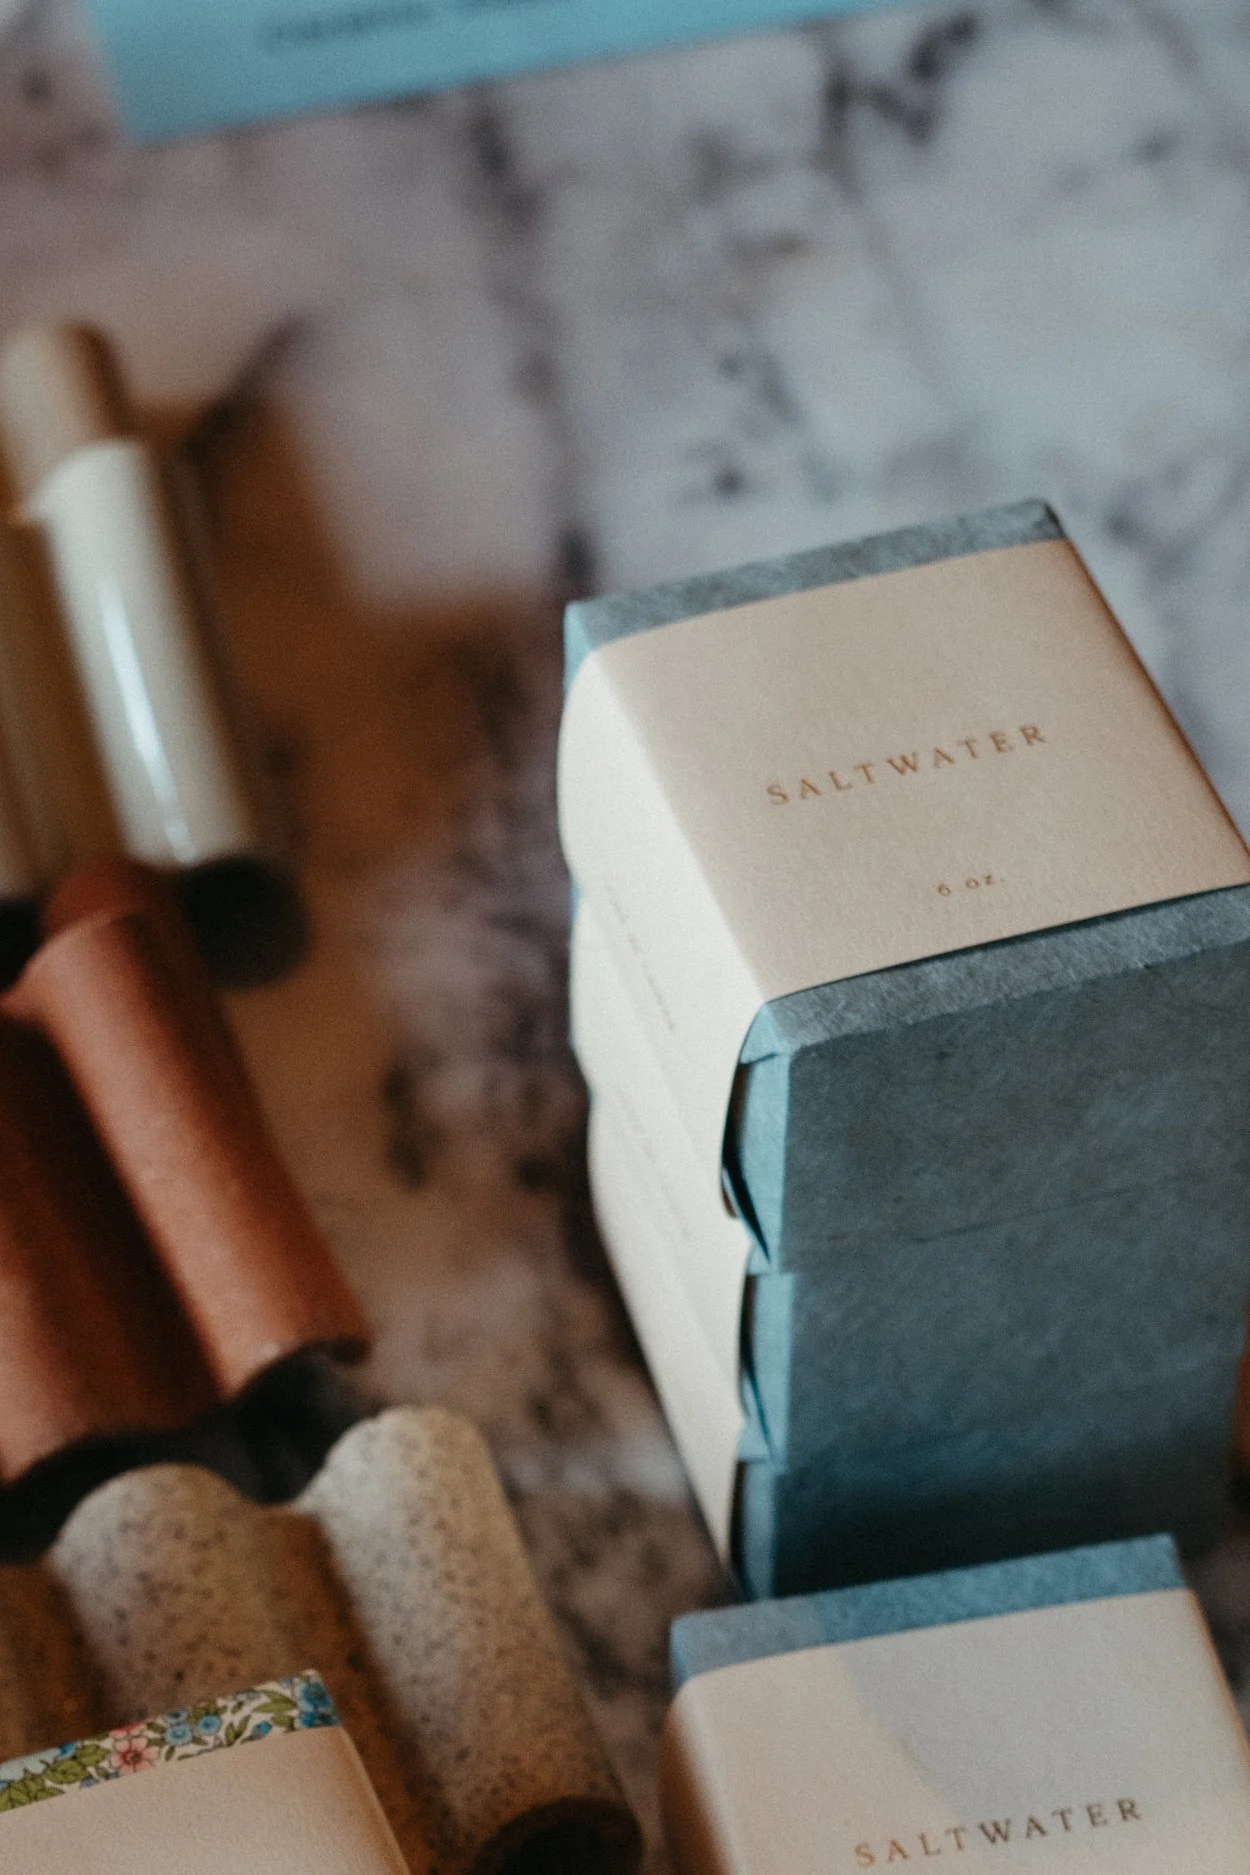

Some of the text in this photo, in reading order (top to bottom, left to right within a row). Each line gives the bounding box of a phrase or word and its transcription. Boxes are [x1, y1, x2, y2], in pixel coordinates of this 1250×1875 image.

[767, 723, 1046, 805] SALTWATER
[937, 882, 952, 897] 6
[855, 1797, 1142, 1867] SALTWATER
